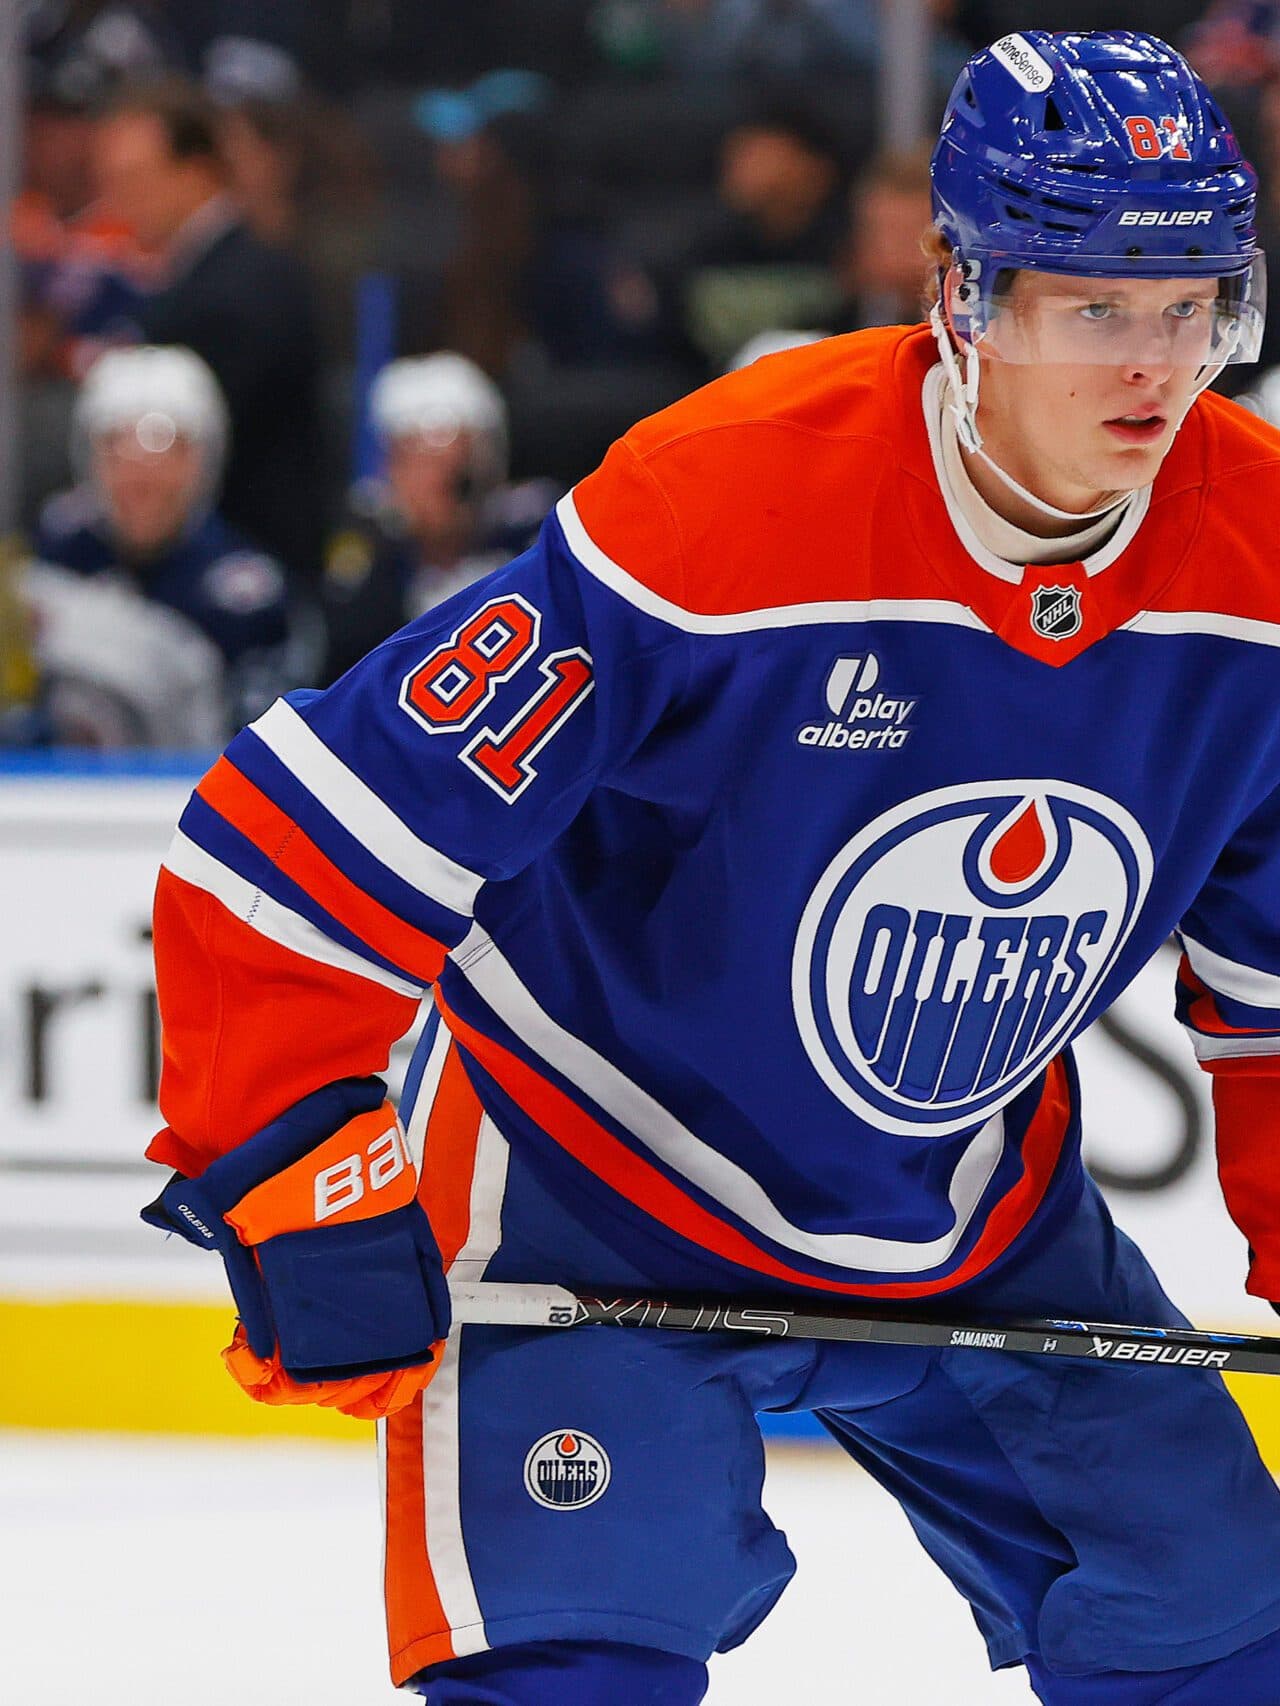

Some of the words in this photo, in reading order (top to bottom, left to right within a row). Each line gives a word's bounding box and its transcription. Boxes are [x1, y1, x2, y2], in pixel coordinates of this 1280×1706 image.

[1123, 116, 1192, 161] 81
[1042, 599, 1072, 629] NHL
[398, 592, 595, 805] 81
[847, 692, 916, 725] play
[797, 721, 909, 749] alberta
[848, 903, 1108, 1104] OILERS
[950, 1330, 1007, 1349] SAMANSKI
[537, 1459, 598, 1503] OILERS
